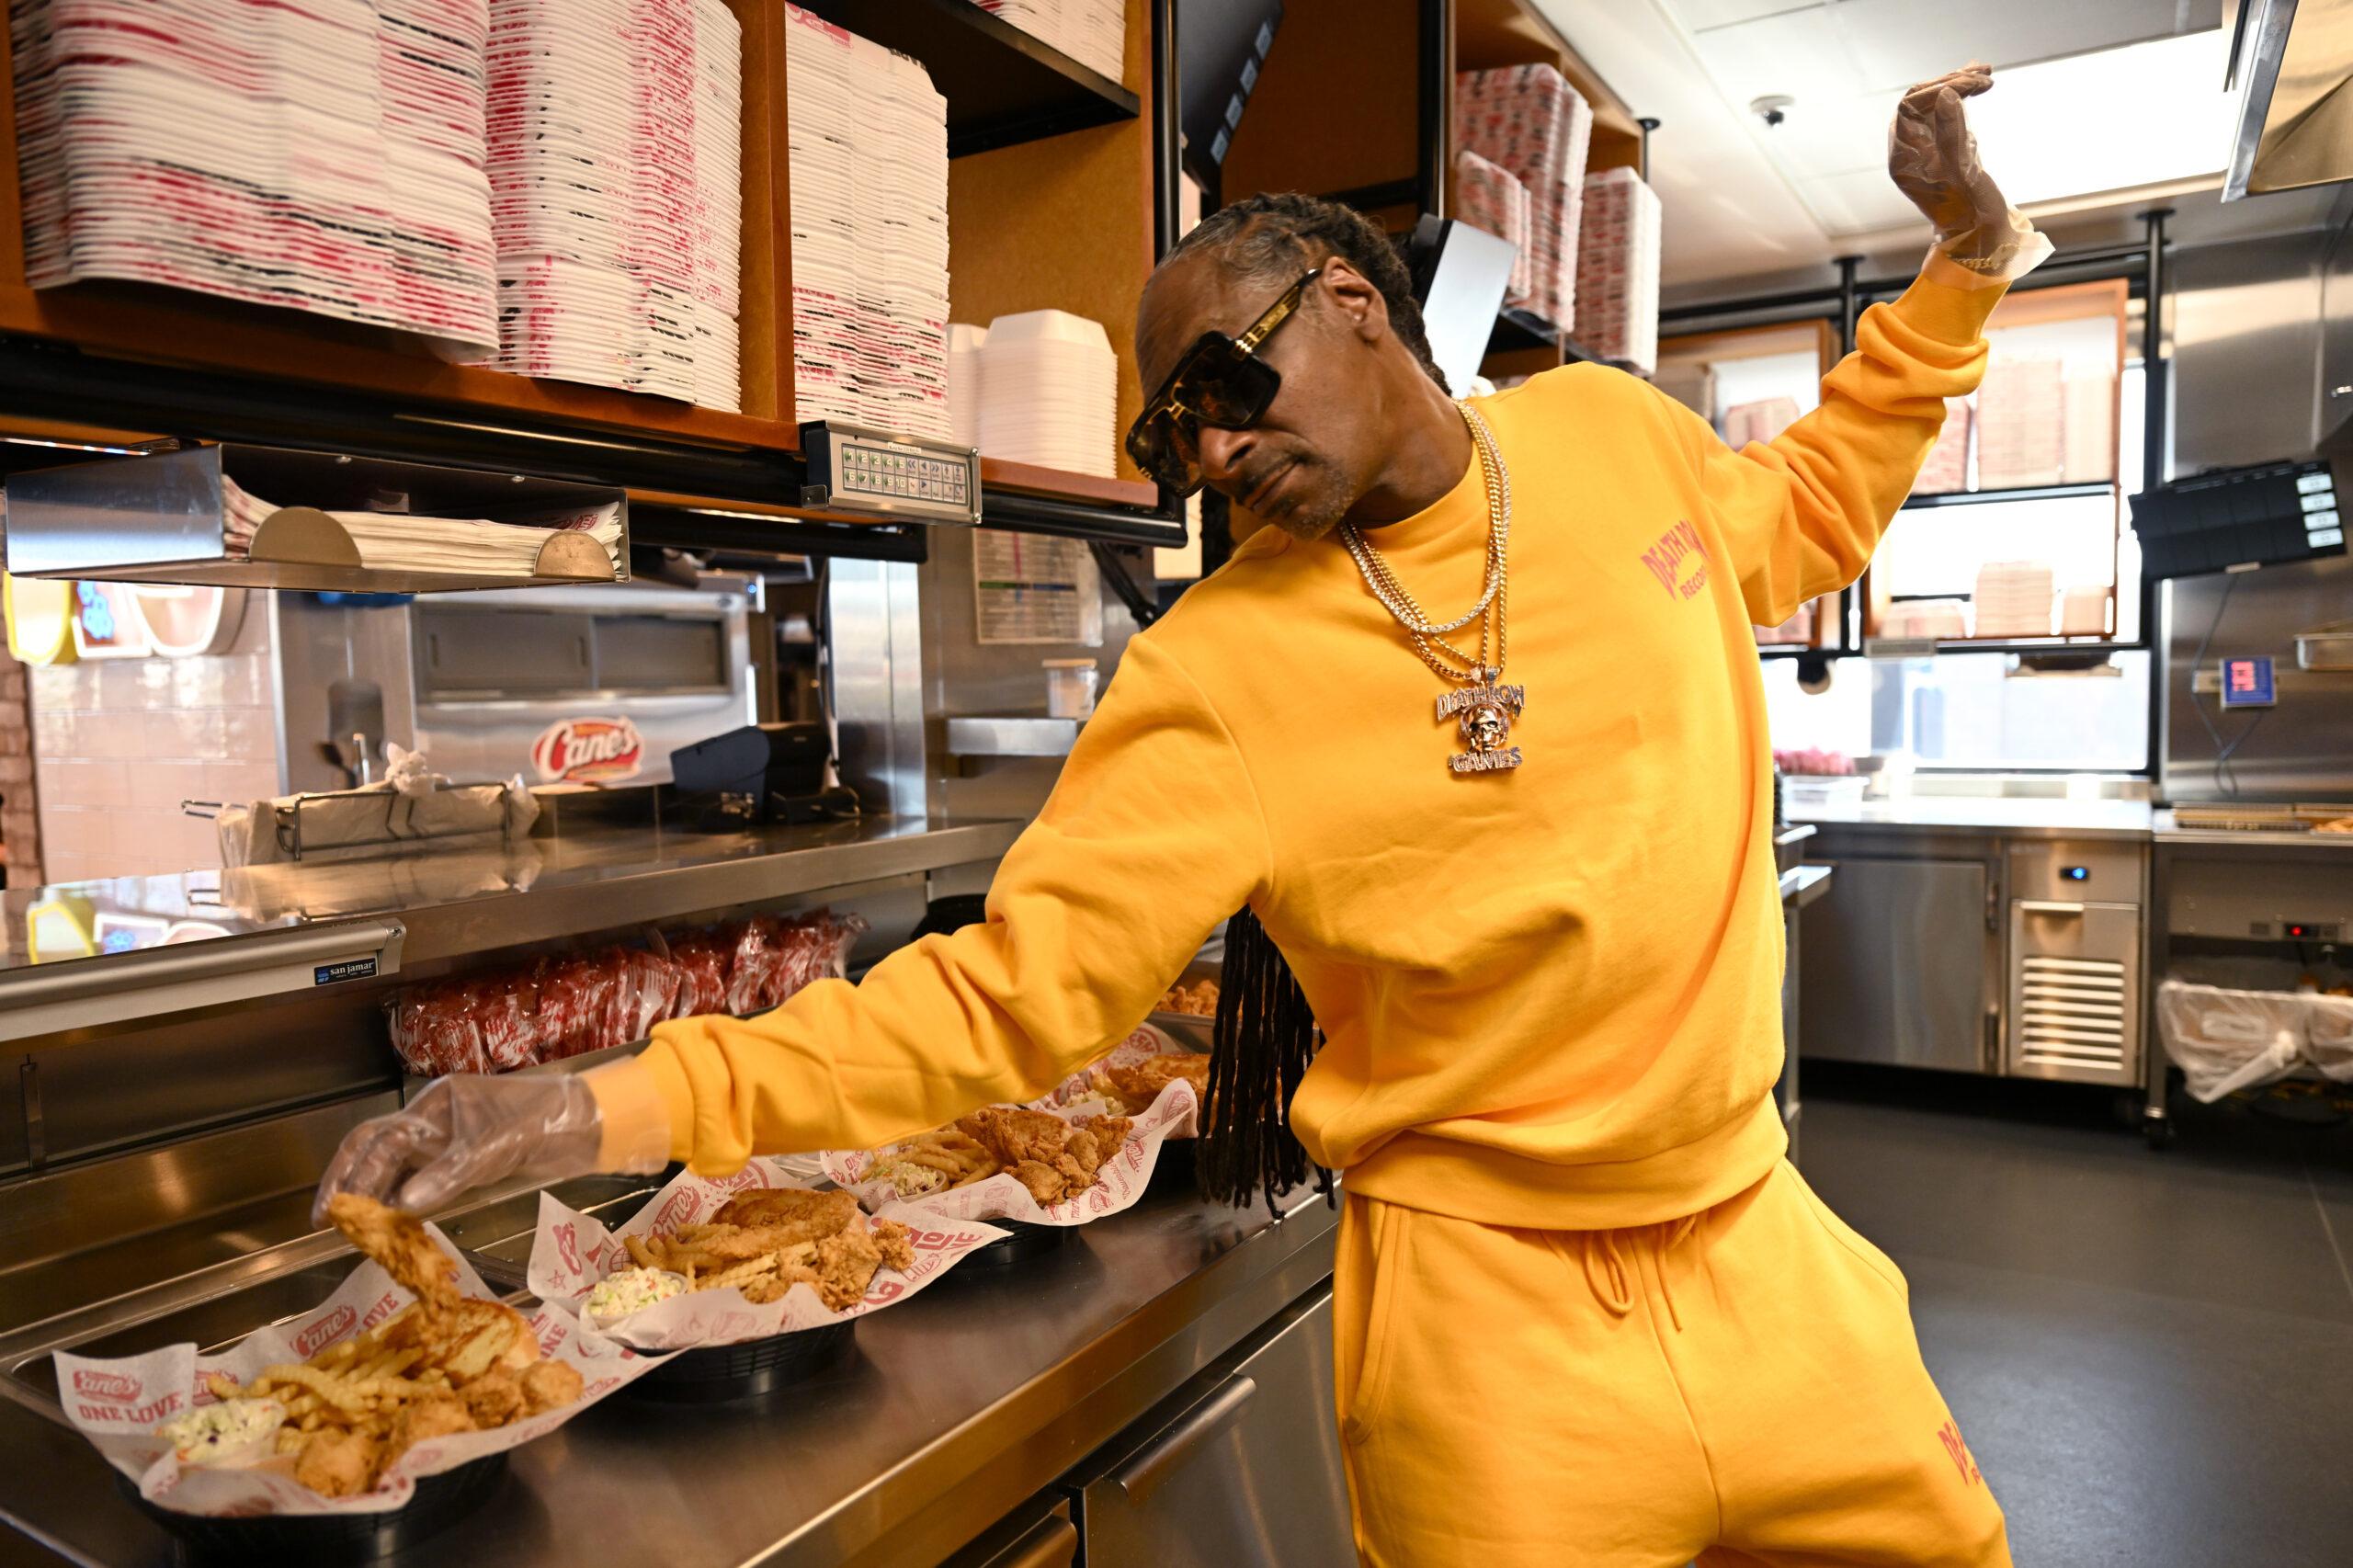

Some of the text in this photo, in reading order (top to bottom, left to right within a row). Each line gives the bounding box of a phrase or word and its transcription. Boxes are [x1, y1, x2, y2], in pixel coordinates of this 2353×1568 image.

[1640, 528, 1688, 602] DEATH
[1438, 681, 1525, 722] DEATH ROW
[539, 716, 638, 781] Cane's
[1449, 746, 1522, 772] GAMES
[330, 967, 346, 975] san
[347, 961, 375, 974] jamar
[290, 1303, 355, 1361] Cane's
[78, 1391, 184, 1424] ONE LOVE
